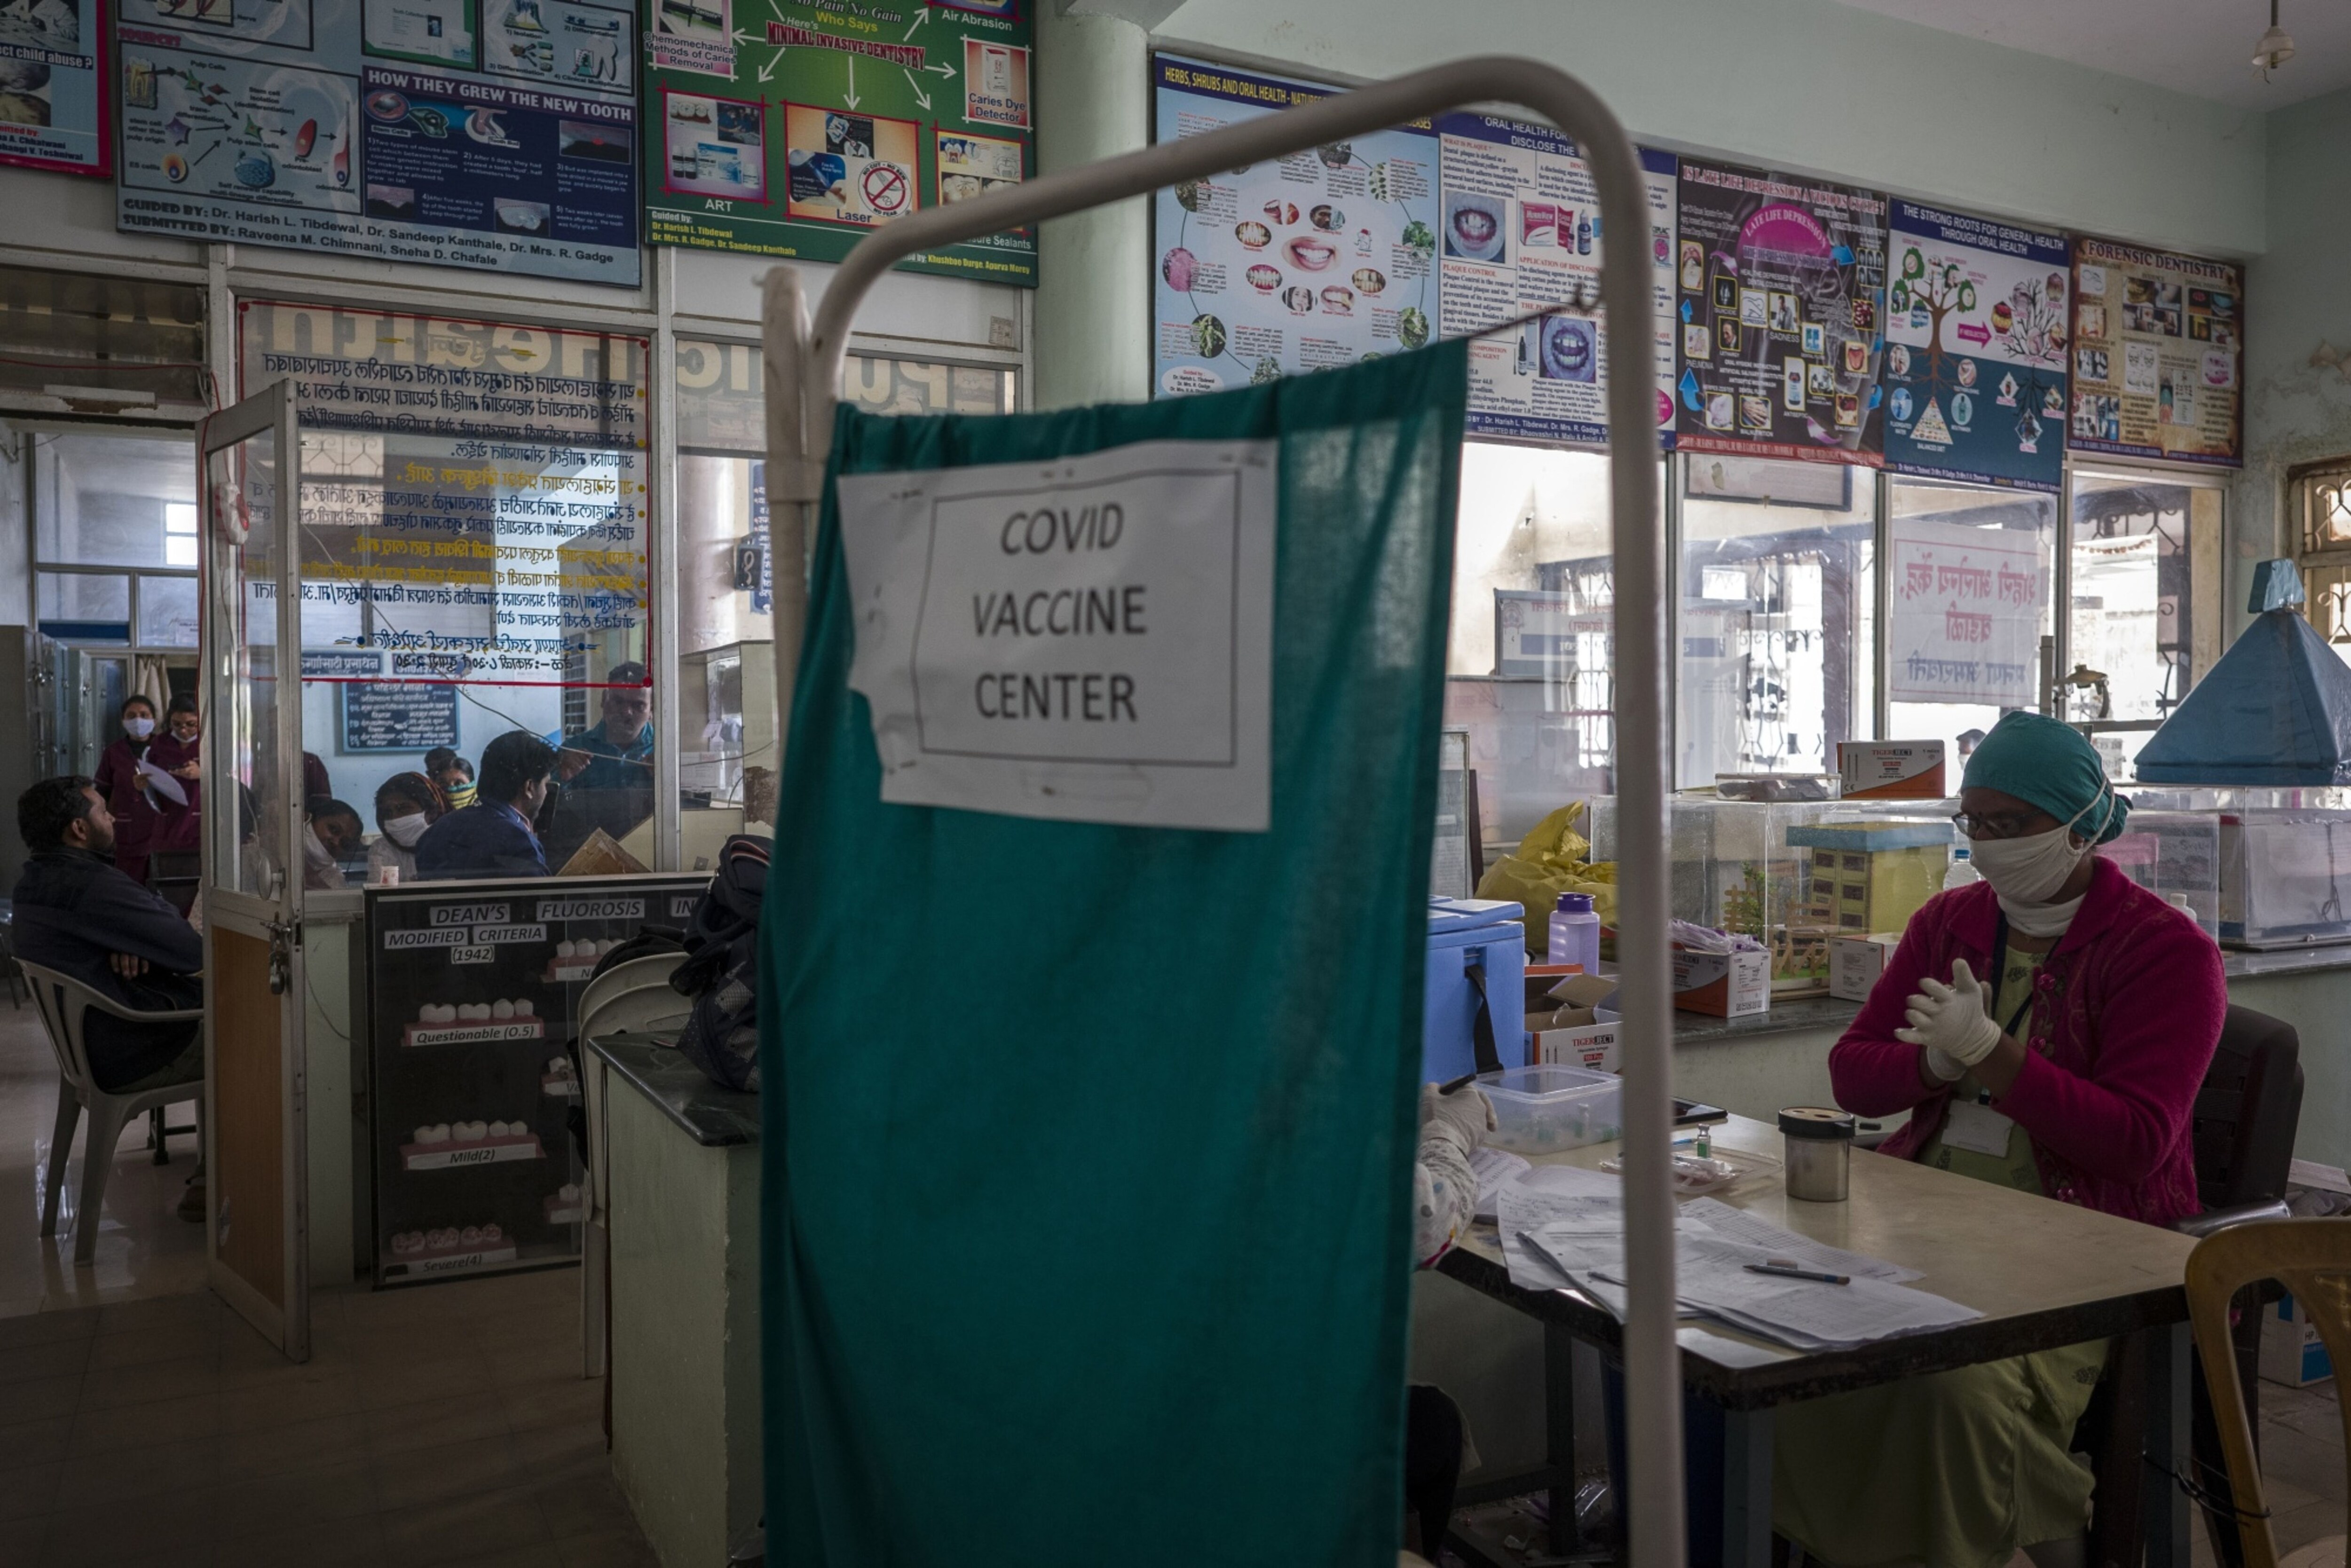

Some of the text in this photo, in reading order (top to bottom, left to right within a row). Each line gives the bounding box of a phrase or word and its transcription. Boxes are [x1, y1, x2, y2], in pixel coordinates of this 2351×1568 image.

[814, 0, 845, 14] Pain
[848, 3, 867, 17] No
[871, 7, 902, 24] Gain
[816, 11, 877, 33] Who Says
[942, 9, 1012, 31] Air Abrasion
[787, 17, 818, 32] Here's
[646, 43, 737, 65] Methods of Caries
[767, 20, 925, 72] MINIMAL INVASIVE DENTISTRY
[16, 48, 46, 62] child
[47, 53, 83, 68] abuse
[670, 56, 713, 70] Removal
[368, 70, 631, 121] HOW THEY GREW THE NEW TOOTH
[1165, 67, 1191, 88] HERBS,
[1192, 73, 1222, 91] SHRUBS
[1222, 79, 1239, 95] AND
[1239, 82, 1259, 99] ORAL
[1259, 86, 1286, 104] HEALTH
[969, 93, 1026, 112] Caries Dye
[975, 108, 1021, 121] Detector
[1485, 117, 1568, 142] ORAL HEALTH FOR
[1511, 135, 1575, 156] DISCLOSE THE
[705, 198, 733, 212] ART
[652, 211, 693, 224] Guided by:
[837, 209, 872, 223] Laser
[123, 198, 614, 264] GUIDED BY: Dr. Harish L. Tibdewal, Dr. Sandeep Kanthale, Dr. Mrs. R. Gadge
[663, 223, 689, 233] Harish
[698, 227, 733, 238] Tibdewal
[1903, 205, 2064, 251] THE STRONG ROOTS FOR GENERAL HEALTH
[123, 214, 497, 265] SUBMITTED BY: Raveena M. Chimnani, Sneha D. Chafale
[994, 235, 1032, 250] Sealants
[1941, 226, 2028, 255] THROUGH ORAL HEALTH
[2089, 242, 2154, 266] FORENSIC
[2155, 255, 2227, 279] DENTISTRY
[1000, 501, 1125, 556] COVID
[972, 584, 1149, 638] VACCINE
[974, 671, 1139, 724] CENTER
[540, 900, 641, 920] FLUOROSIS
[388, 926, 543, 947] MODIFIED CRITERIA
[451, 947, 494, 963] (1942)
[417, 1028, 501, 1044] Questionable
[1572, 1034, 1614, 1047] TIGERJECT
[450, 1149, 496, 1165] Mild(2)
[423, 1254, 482, 1273] Severe(4)
